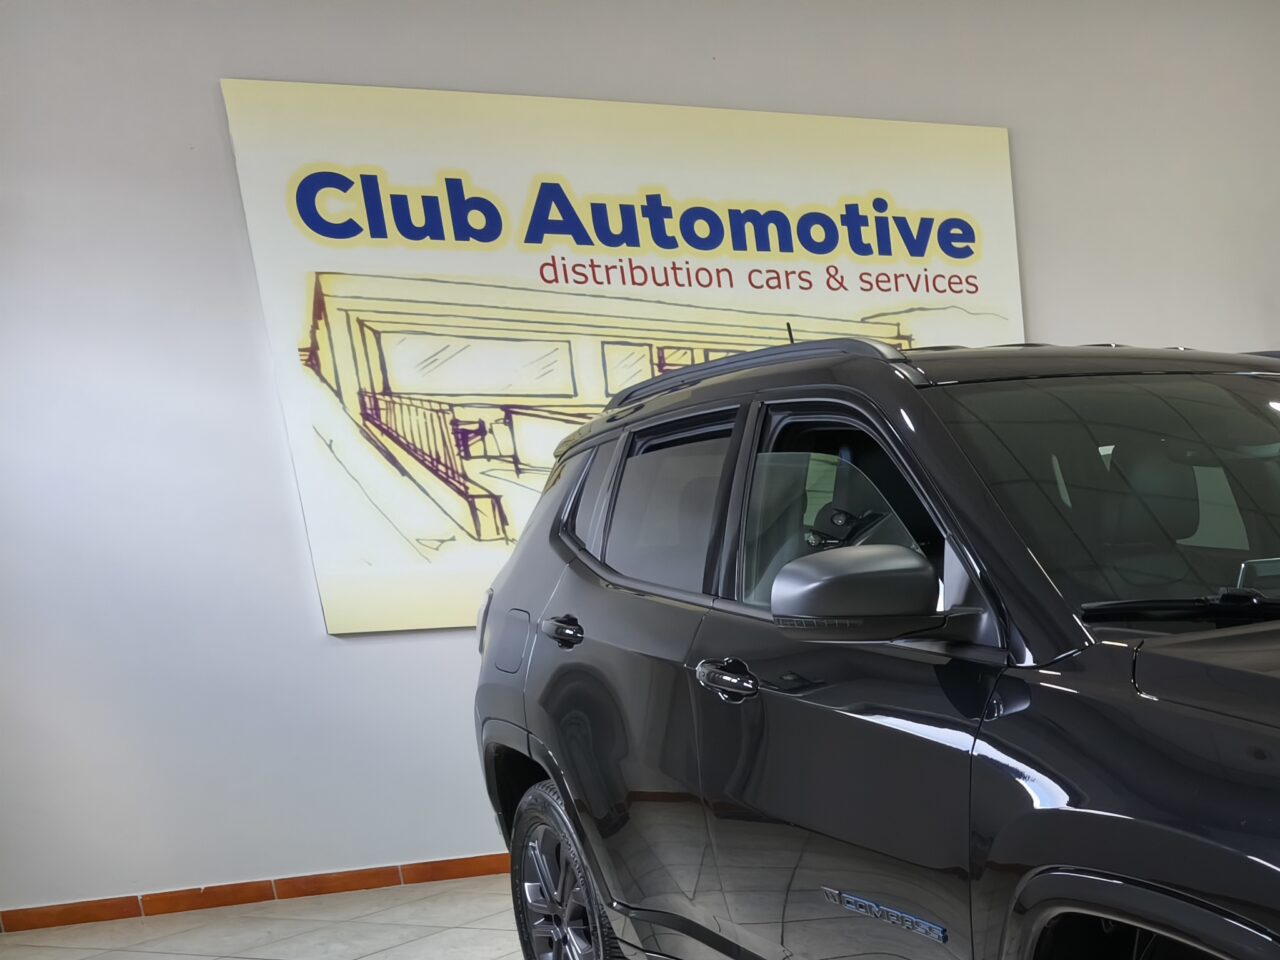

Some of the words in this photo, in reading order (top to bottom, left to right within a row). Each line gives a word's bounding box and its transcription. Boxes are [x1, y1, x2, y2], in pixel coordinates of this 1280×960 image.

[296, 171, 503, 243] Club
[524, 182, 976, 259] Automotive
[539, 255, 734, 289] distribution
[748, 268, 813, 291] cars
[825, 265, 848, 292] &
[859, 268, 979, 294] services
